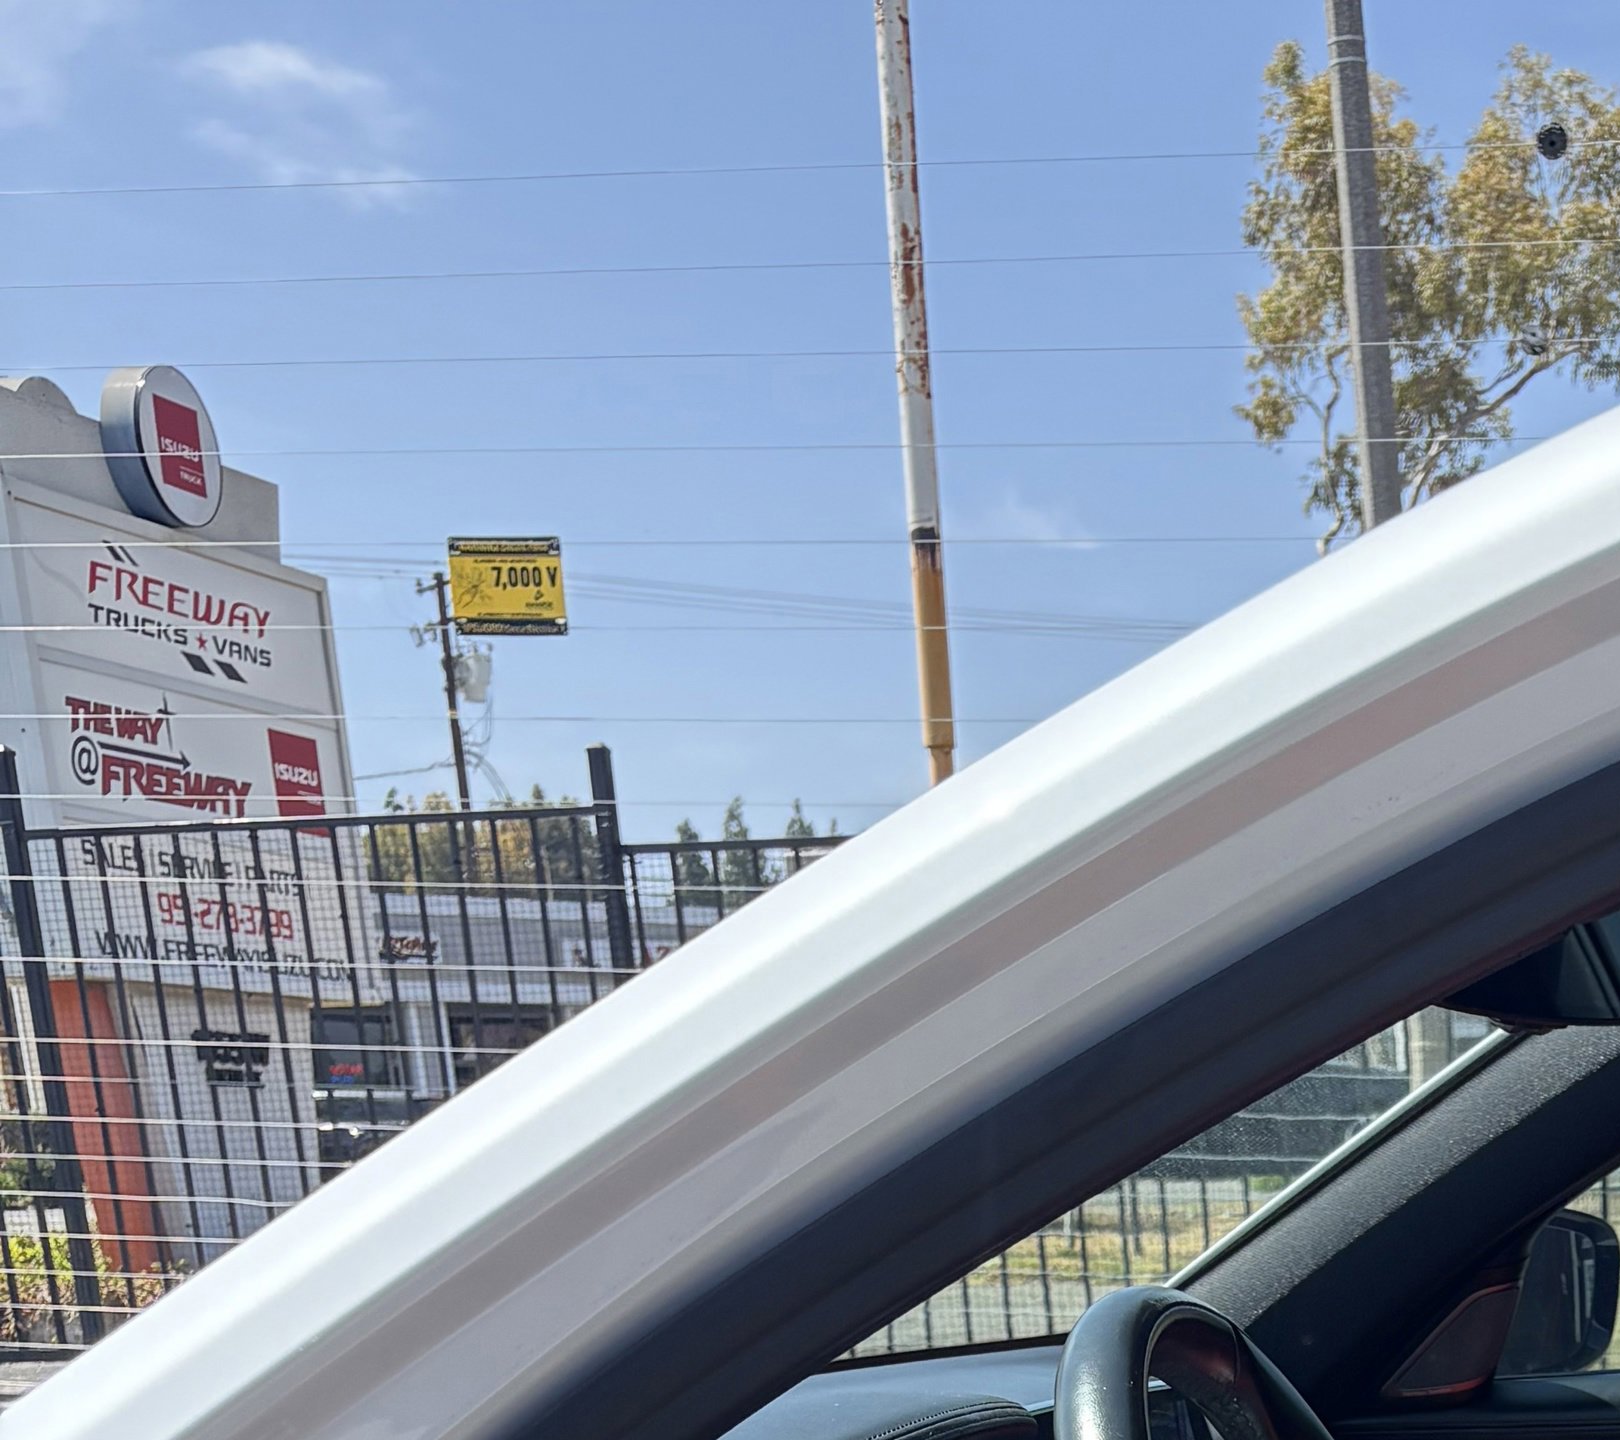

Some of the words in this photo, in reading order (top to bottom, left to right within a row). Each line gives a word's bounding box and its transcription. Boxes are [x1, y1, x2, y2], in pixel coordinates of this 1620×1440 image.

[160, 435, 200, 462] ISUZU
[490, 566, 541, 590] 7,000
[88, 560, 270, 638] FREEWAY
[87, 602, 188, 645] TRUCKS
[211, 634, 272, 666] VANS
[274, 762, 318, 786] ISUZU
